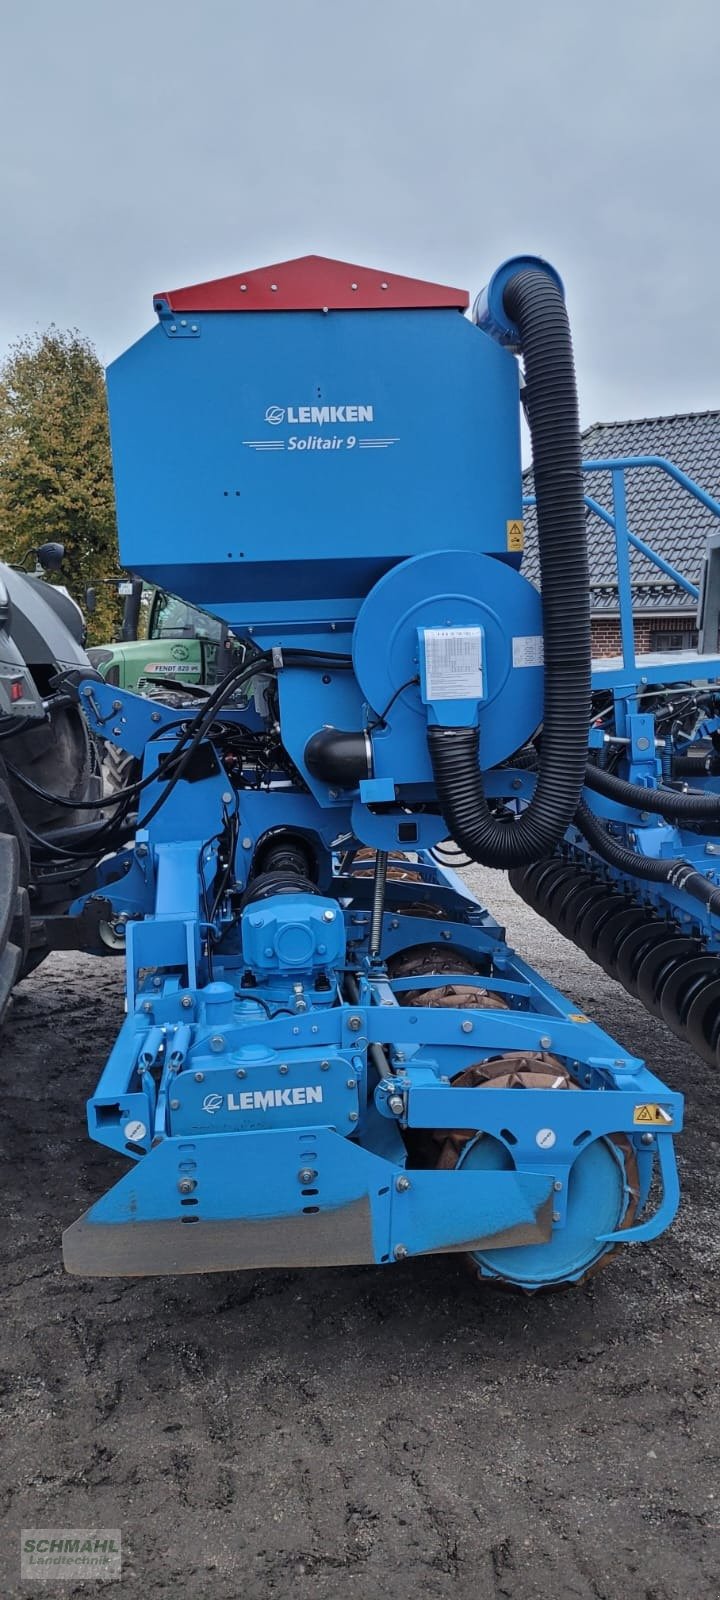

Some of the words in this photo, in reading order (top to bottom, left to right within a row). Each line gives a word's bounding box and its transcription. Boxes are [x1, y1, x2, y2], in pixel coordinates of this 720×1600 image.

[287, 405, 373, 427] LEMKEN
[287, 436, 344, 450] Solitair
[346, 436, 357, 450] 9
[227, 1085, 323, 1112] LEMKEN
